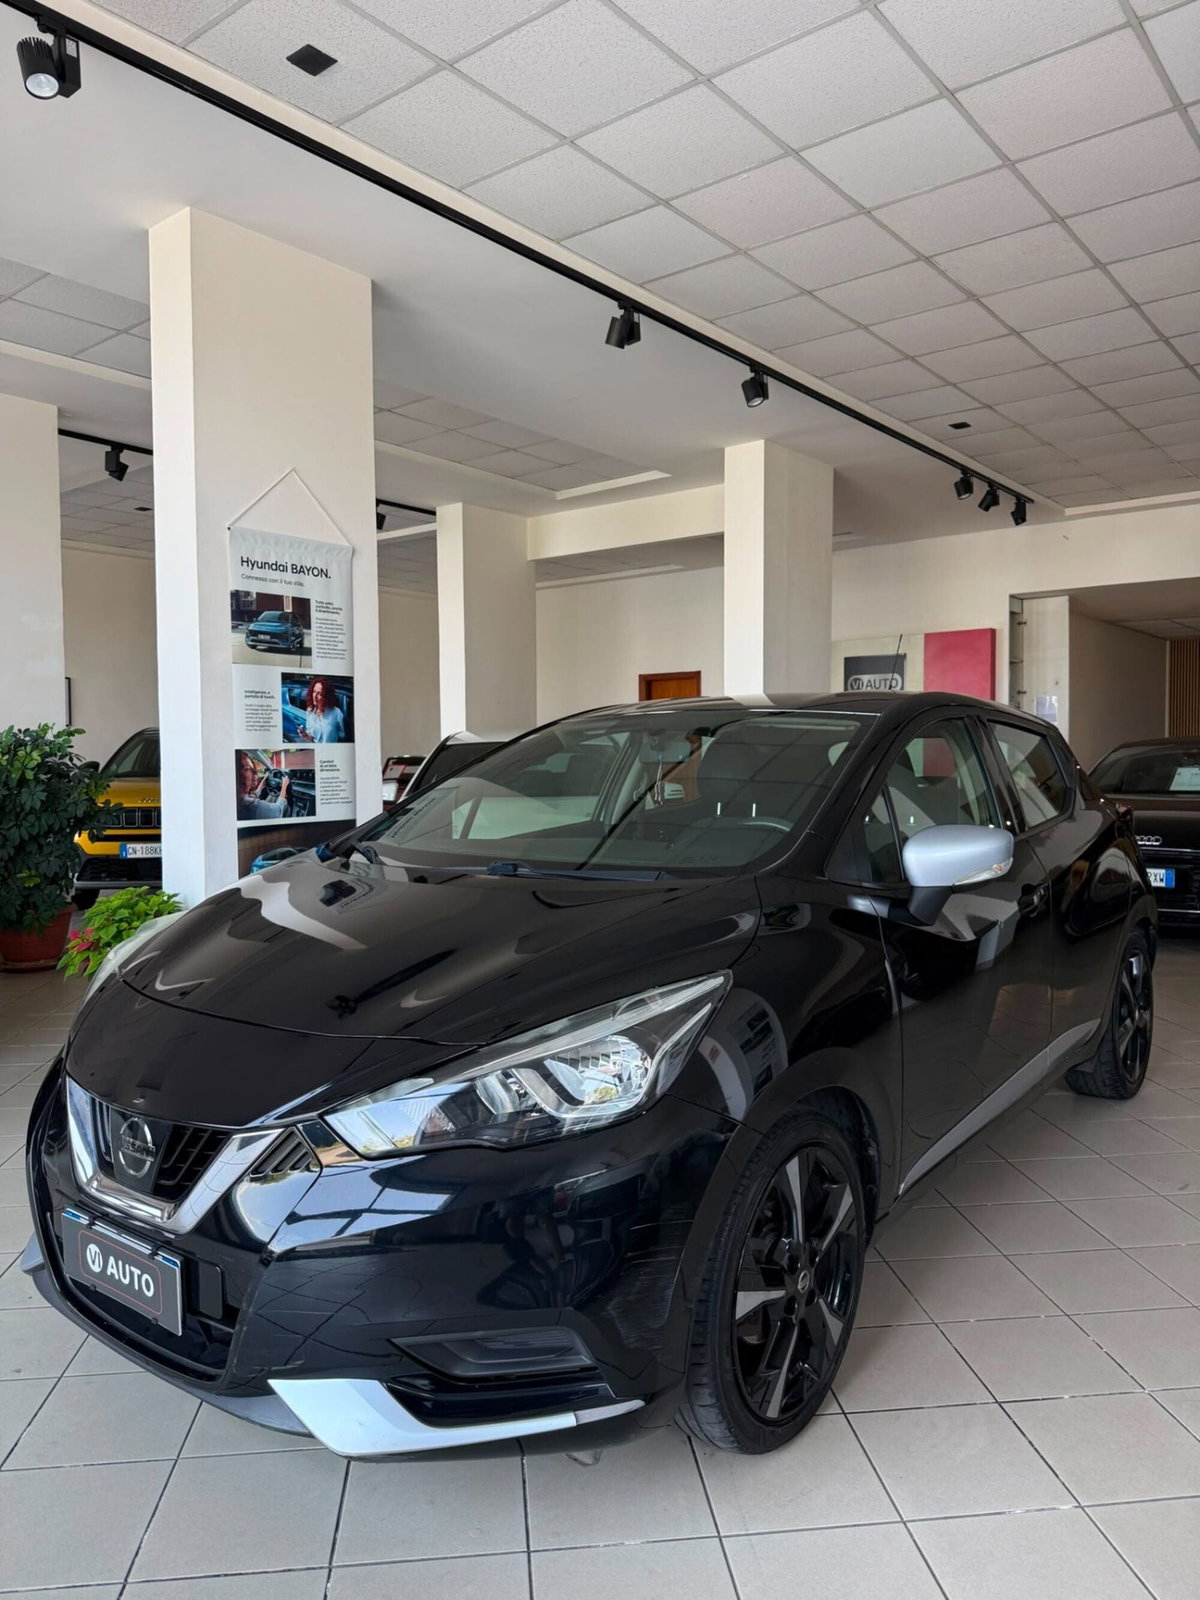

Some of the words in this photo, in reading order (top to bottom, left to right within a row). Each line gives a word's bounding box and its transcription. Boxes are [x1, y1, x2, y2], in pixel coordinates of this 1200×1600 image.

[240, 556, 288, 573] Hyundai
[291, 563, 332, 579] BAYON.
[865, 678, 899, 690] AUTO
[106, 1255, 155, 1298] AUTO
